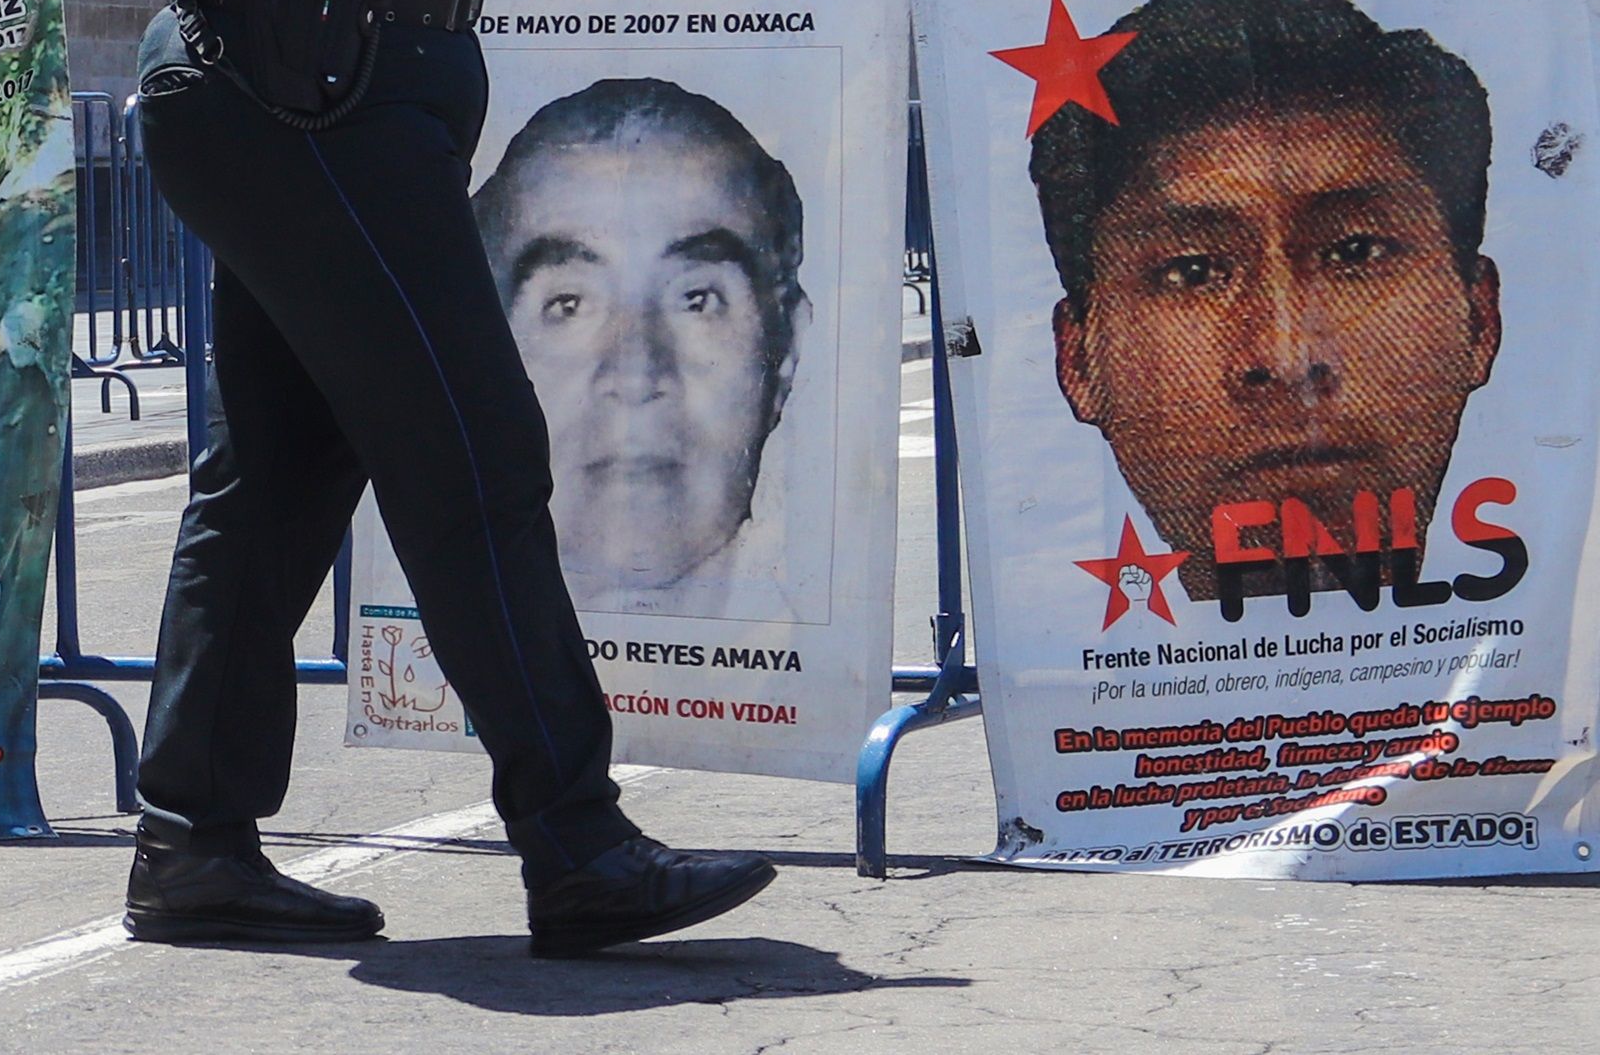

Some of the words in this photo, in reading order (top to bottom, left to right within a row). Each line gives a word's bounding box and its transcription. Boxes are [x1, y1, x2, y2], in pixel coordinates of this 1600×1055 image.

[480, 16, 509, 34] DE
[517, 15, 581, 34] MAYO
[588, 15, 616, 33] DE
[624, 14, 679, 33] 2007
[687, 14, 716, 33] EN
[723, 12, 815, 32] OAXACA
[1211, 476, 1529, 623] FNLS
[362, 625, 375, 672] Hasta
[627, 642, 704, 667] REYES
[712, 647, 802, 672] AMAYA
[1083, 649, 1150, 670] Frente
[1158, 639, 1247, 666] Nacional
[1254, 638, 1278, 659] de
[1285, 632, 1343, 656] Lucha
[1351, 632, 1383, 656] por
[1390, 626, 1407, 647] el
[1413, 616, 1524, 645] Socialismo
[1092, 680, 1126, 705] ¡Por
[1131, 678, 1146, 699] la
[1151, 671, 1210, 697] unidad,
[1215, 670, 1270, 694] obrero,
[1275, 666, 1343, 692] indígena,
[1349, 657, 1431, 685] campesino
[1434, 658, 1448, 679] y
[1447, 649, 1522, 675] popular!
[676, 698, 723, 719] CON
[731, 701, 797, 725] VIDA!
[1057, 730, 1091, 751] En
[1094, 728, 1118, 748] la
[1123, 721, 1222, 747] memoria
[1227, 717, 1262, 741] del
[1267, 711, 1346, 739] Pueblo
[1349, 705, 1420, 735] queda
[1423, 701, 1448, 723] tu
[1452, 695, 1555, 727] ejemplo
[1136, 746, 1269, 776] honestidad,
[1277, 743, 1367, 765] firmeza
[1368, 743, 1384, 761] y
[1384, 731, 1458, 757] arrojo
[1057, 792, 1086, 810] en
[1091, 787, 1112, 808] la
[1114, 784, 1174, 806] lucha
[1296, 770, 1319, 790] la
[1320, 763, 1411, 786] defensa
[1413, 760, 1449, 780] de
[1453, 760, 1477, 776] la
[1181, 810, 1201, 832] y
[1201, 805, 1242, 829] por
[1269, 788, 1386, 817] Socialismo
[1126, 844, 1150, 861] al
[1159, 823, 1340, 861] TERRORISMO
[1352, 821, 1386, 845] de
